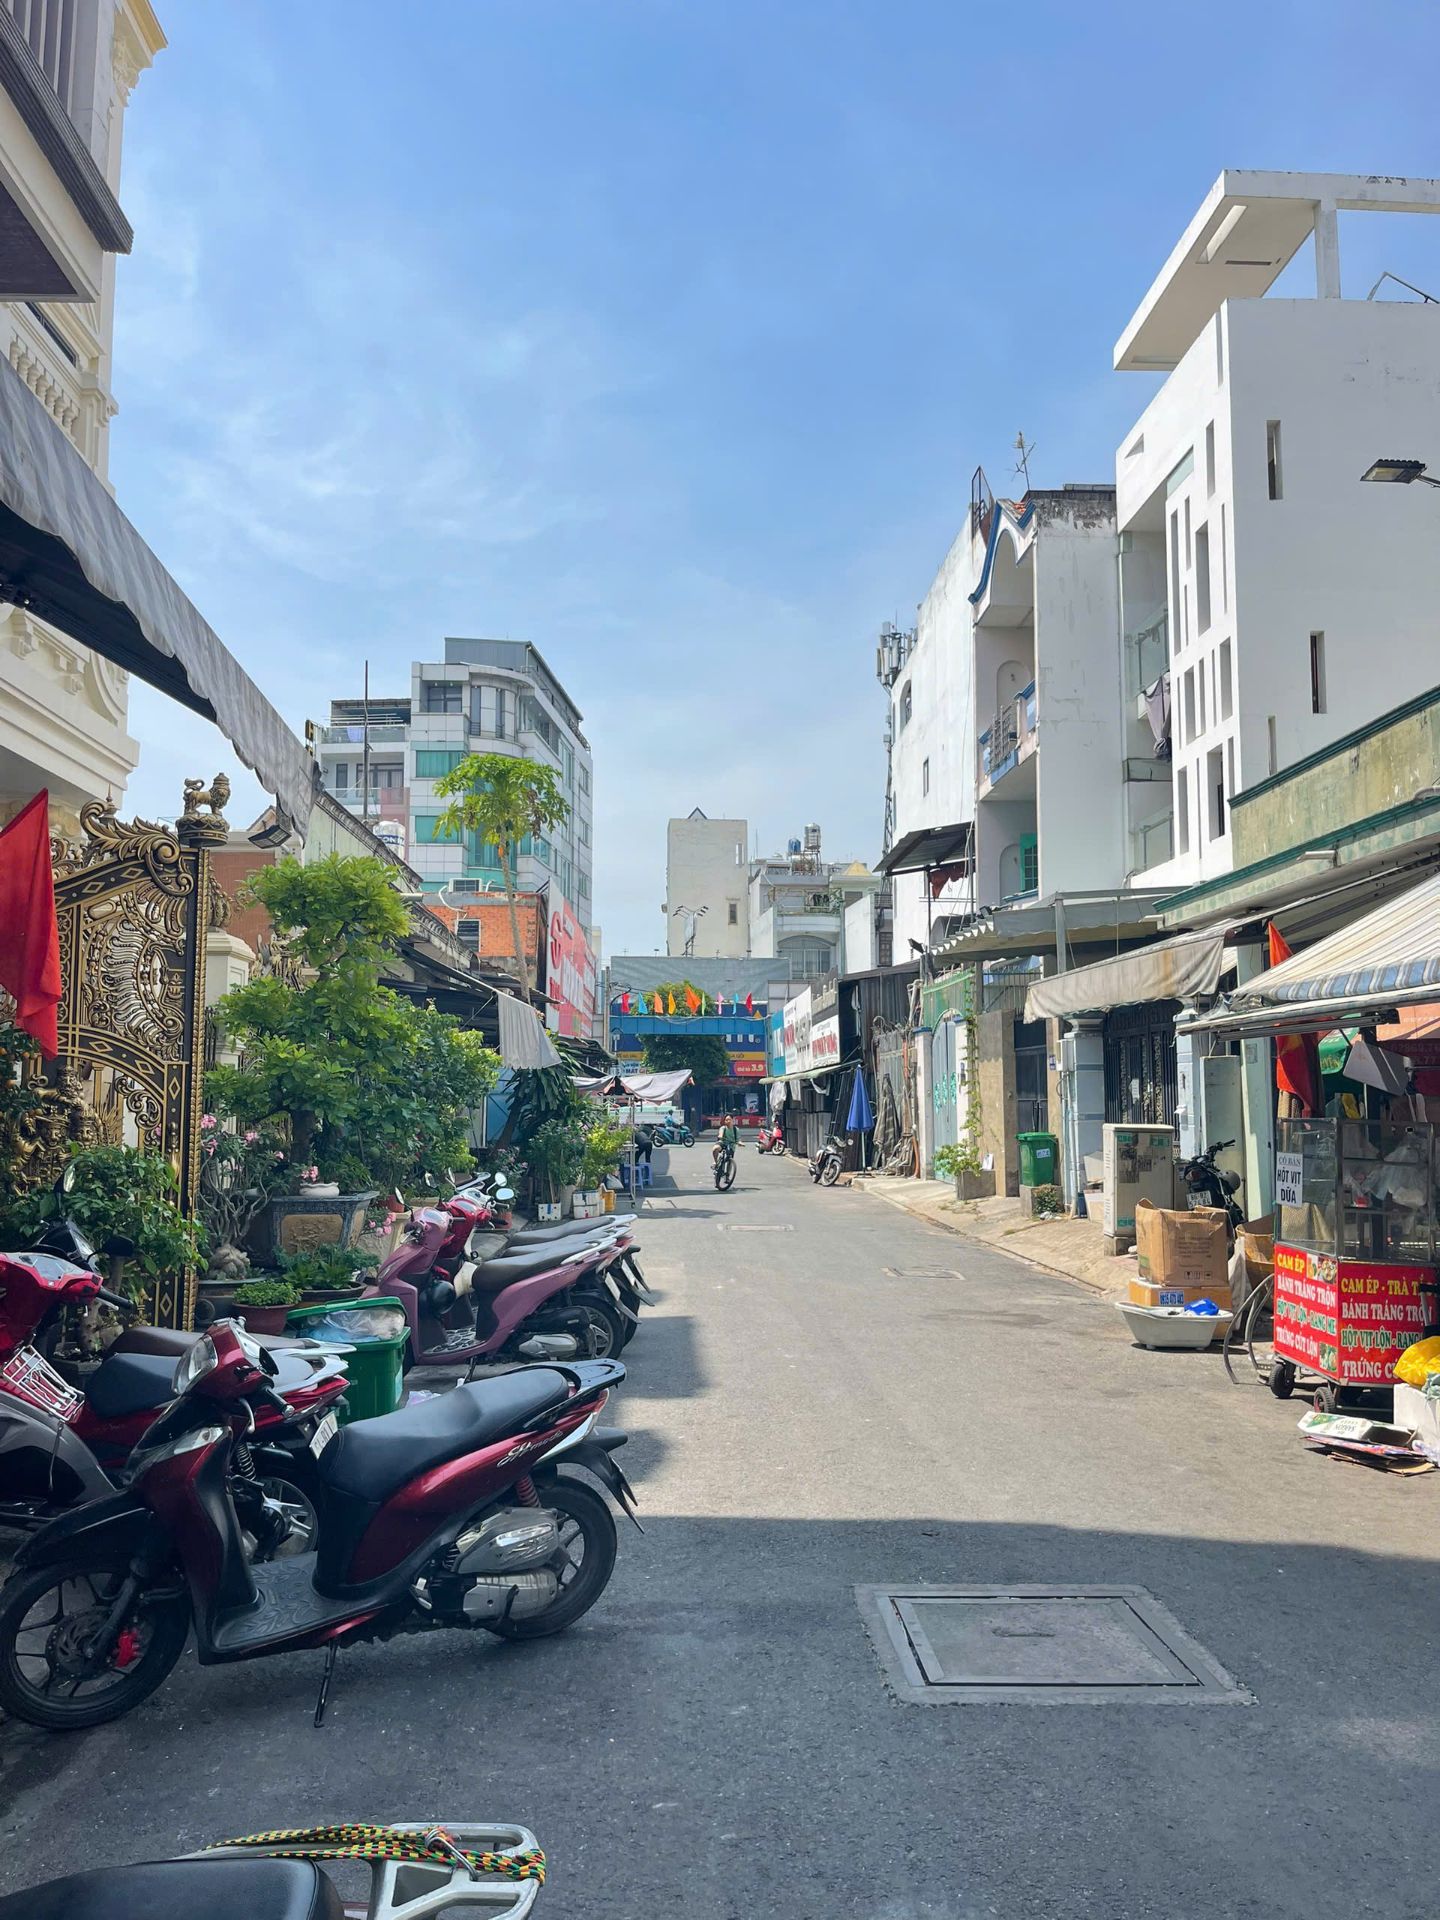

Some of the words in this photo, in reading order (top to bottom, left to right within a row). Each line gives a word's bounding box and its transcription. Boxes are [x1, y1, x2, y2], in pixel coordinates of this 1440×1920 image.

[1277, 1253, 1294, 1270] CAM
[1294, 1255, 1306, 1274] ÉP
[1277, 1272, 1294, 1295] BÁNH
[1294, 1278, 1317, 1302] TRÁNG
[1316, 1285, 1336, 1311] TRỘN
[1341, 1277, 1364, 1294] CAM
[1366, 1274, 1380, 1295] ÉP
[1387, 1275, 1409, 1296] TRÀ
[1341, 1297, 1369, 1320] BÁNH
[1370, 1299, 1404, 1322] TRÁNG
[1276, 1325, 1295, 1348] TRỨNG
[1294, 1331, 1307, 1353] CÚT
[1306, 1335, 1319, 1360] LỘN
[1341, 1324, 1360, 1352] HỘT
[1358, 1329, 1375, 1353] VỊT
[1374, 1325, 1392, 1353] LỘN
[1342, 1357, 1382, 1379] TRỨNG
